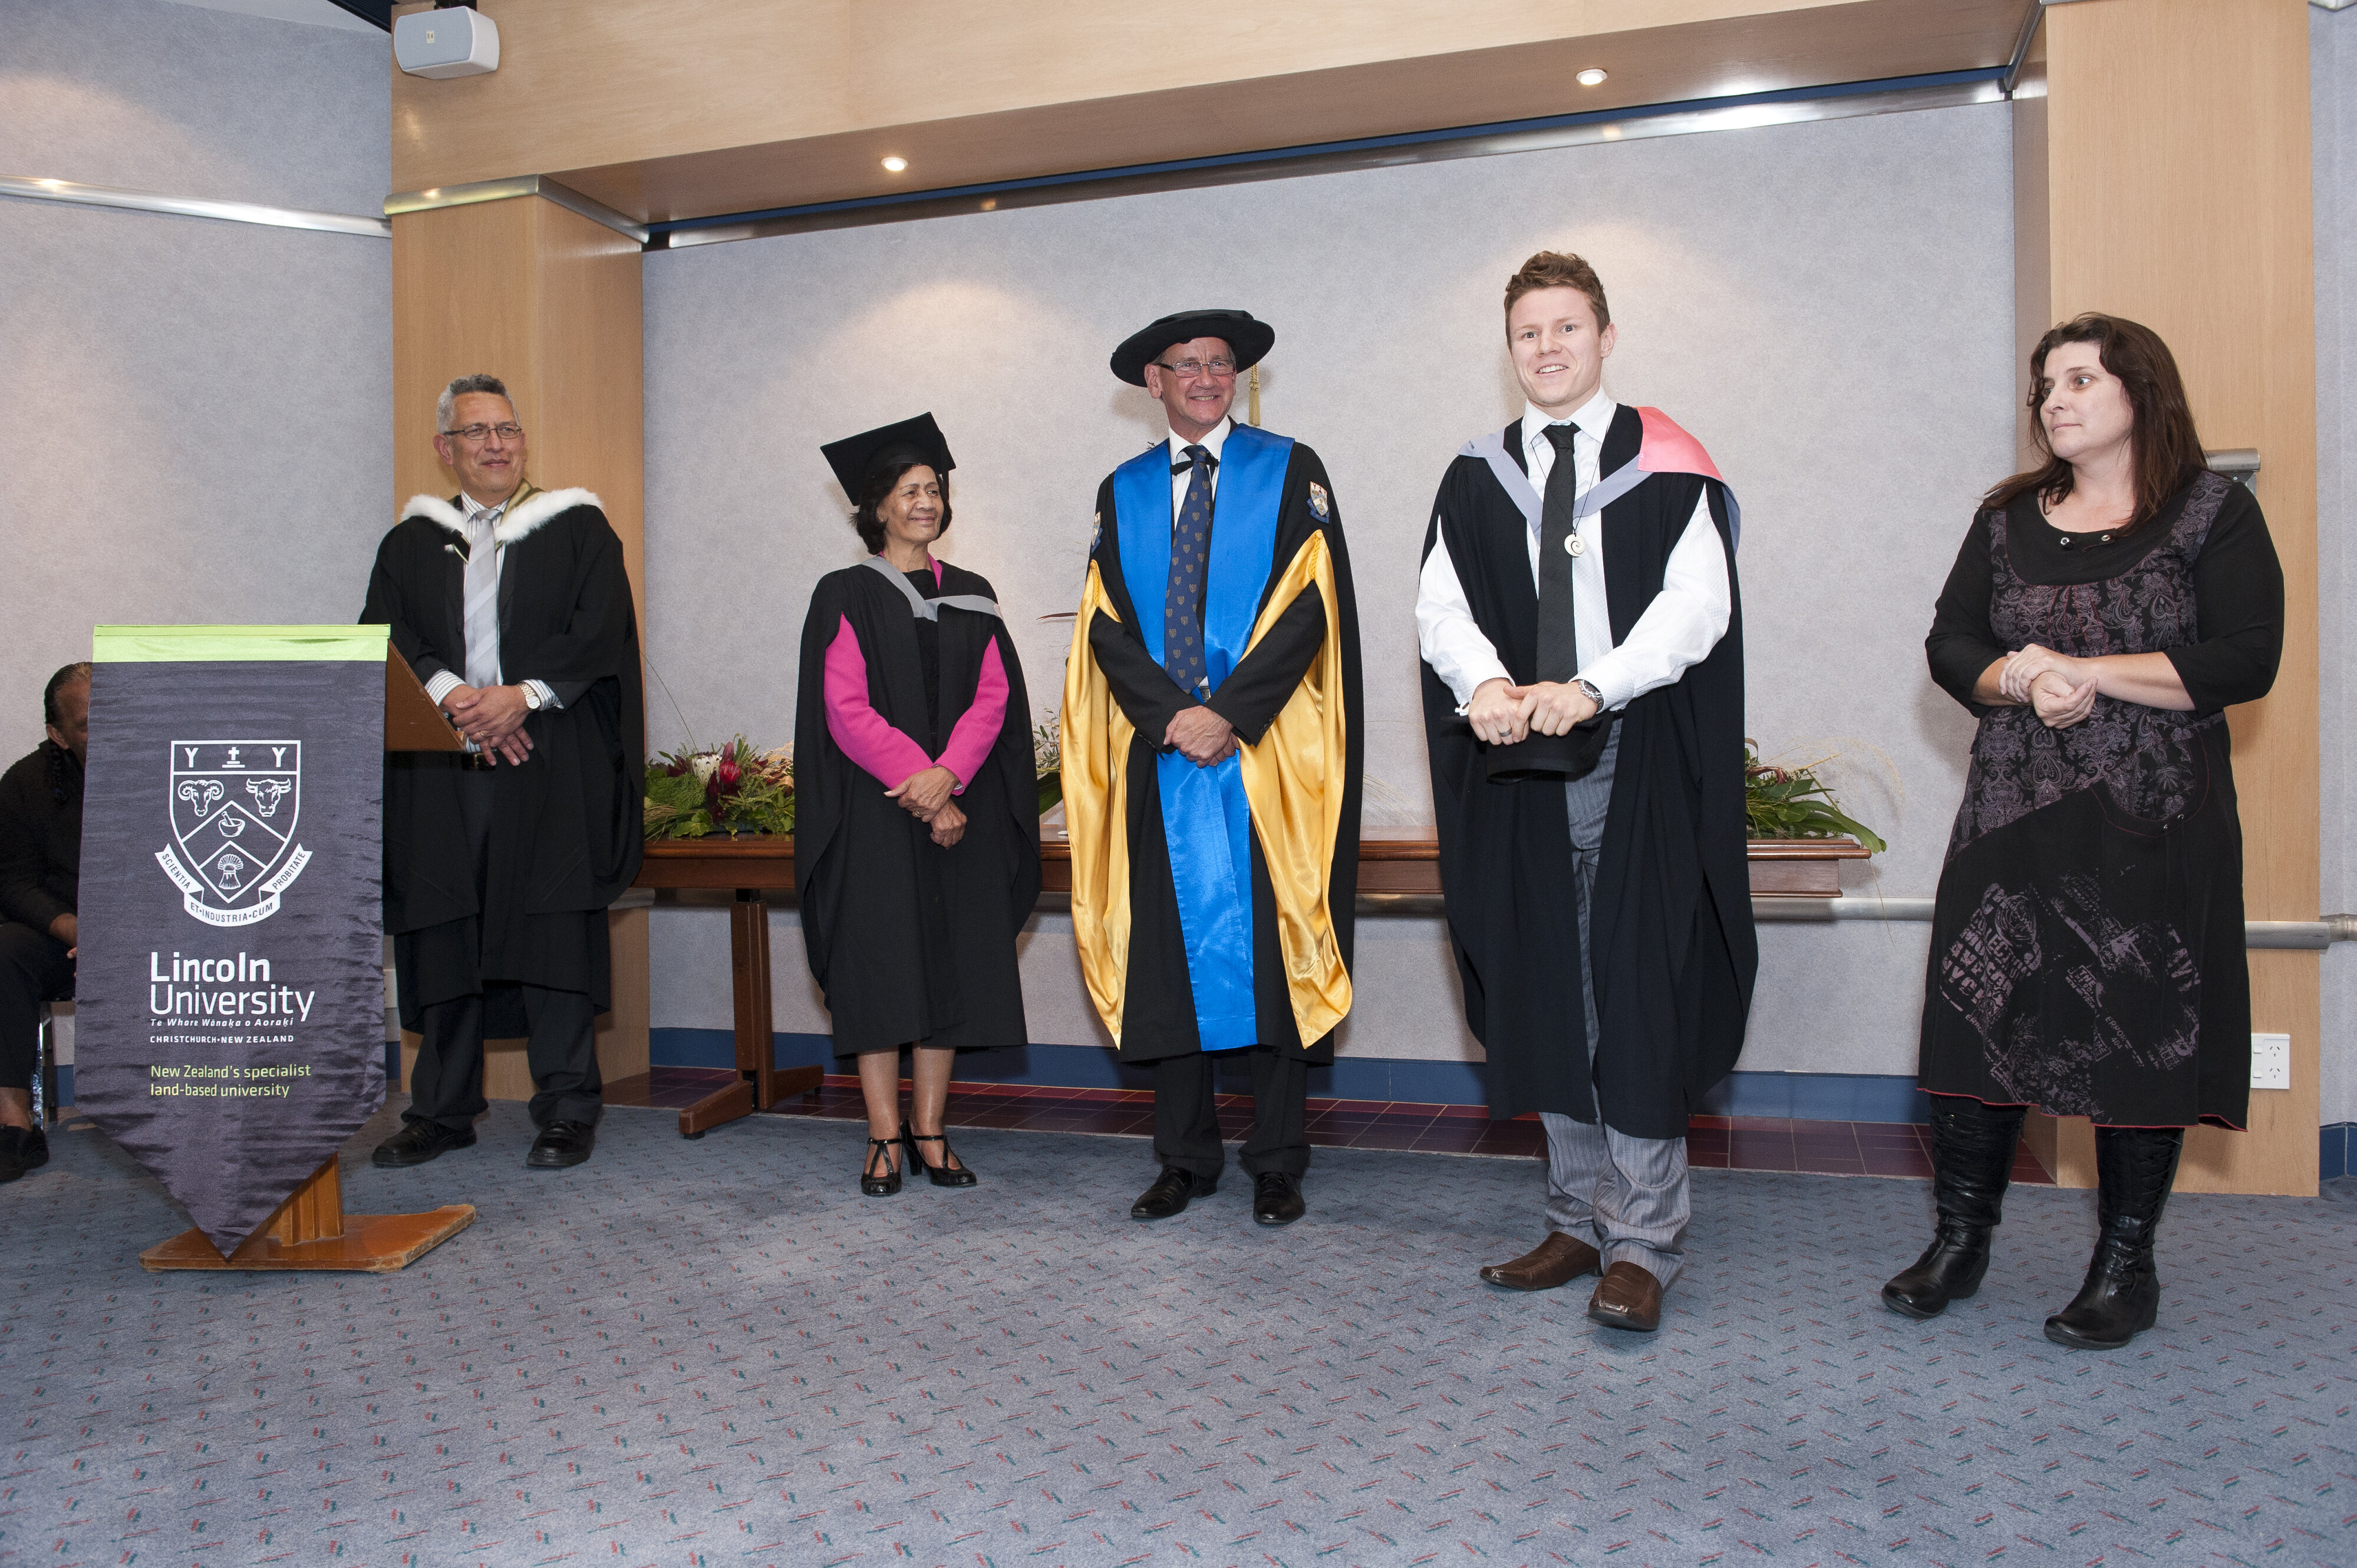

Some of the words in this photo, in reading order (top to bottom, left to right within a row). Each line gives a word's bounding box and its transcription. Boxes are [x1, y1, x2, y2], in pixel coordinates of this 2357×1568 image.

[162, 853, 190, 889] SCIENTIA
[273, 851, 306, 890] PROBITATE
[151, 952, 270, 982] Lincoln
[2079, 969, 2097, 987] THE
[150, 984, 315, 1022] University
[151, 1018, 162, 1026] Te
[167, 1018, 199, 1026] Whare
[1965, 1014, 1985, 1035] ERRO
[246, 1035, 294, 1044] ZEALAND
[151, 1065, 180, 1078] New
[184, 1065, 240, 1078] Zealand's
[244, 1064, 311, 1081] specialist
[151, 1083, 217, 1097] land-based
[220, 1084, 290, 1098] university
